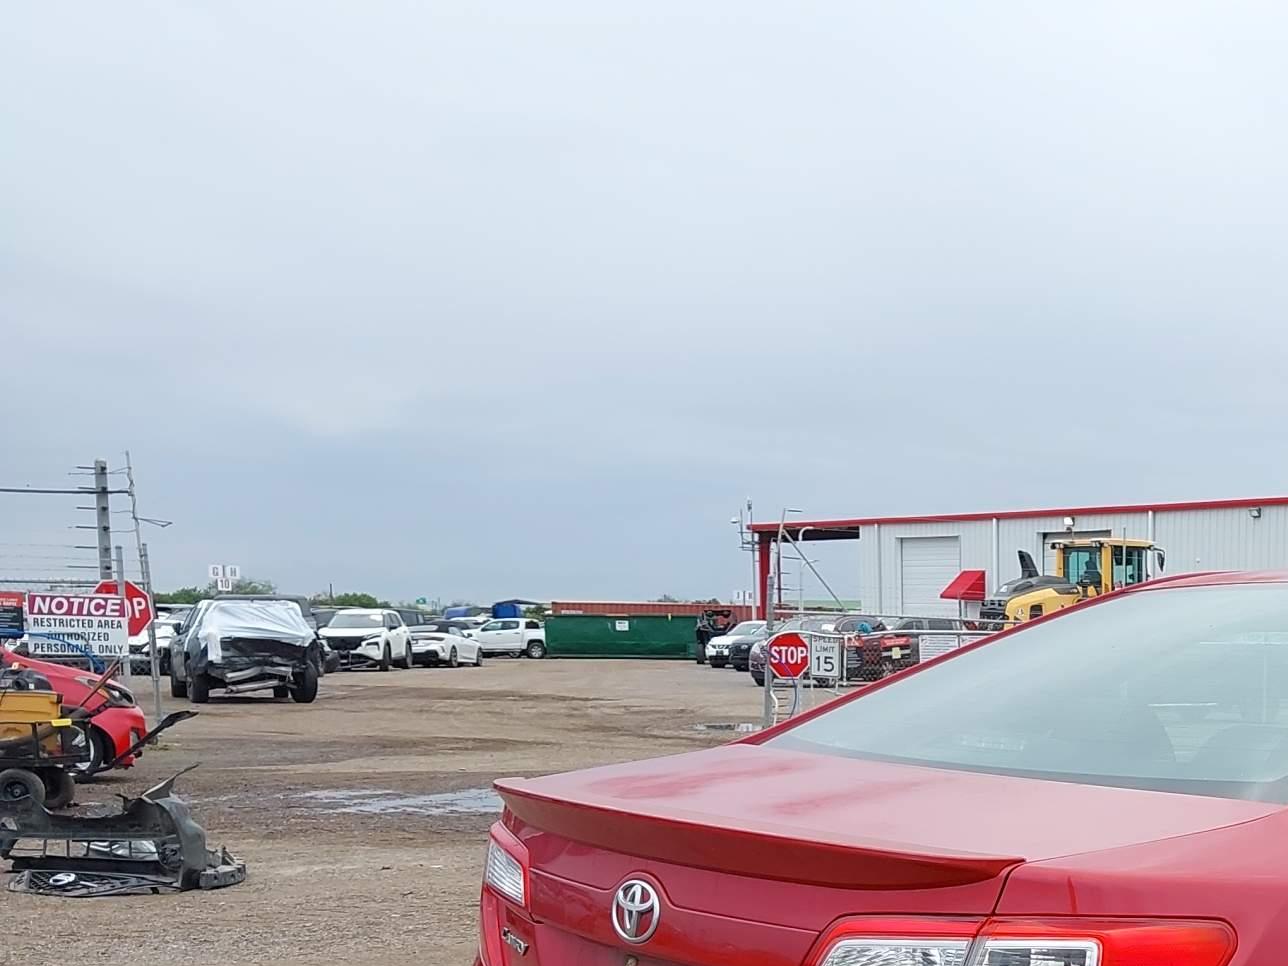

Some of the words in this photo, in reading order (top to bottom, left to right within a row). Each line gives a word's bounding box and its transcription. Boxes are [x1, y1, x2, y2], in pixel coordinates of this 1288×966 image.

[219, 579, 230, 589] 10
[33, 597, 121, 616] NOTICE
[33, 618, 94, 629] RESTRICTED
[97, 619, 123, 630] AREA
[33, 642, 95, 654] PERSONNEL
[98, 644, 124, 655] ONLY
[815, 645, 835, 653] LIMIT
[770, 646, 807, 665] STOP
[815, 656, 835, 672] 15
